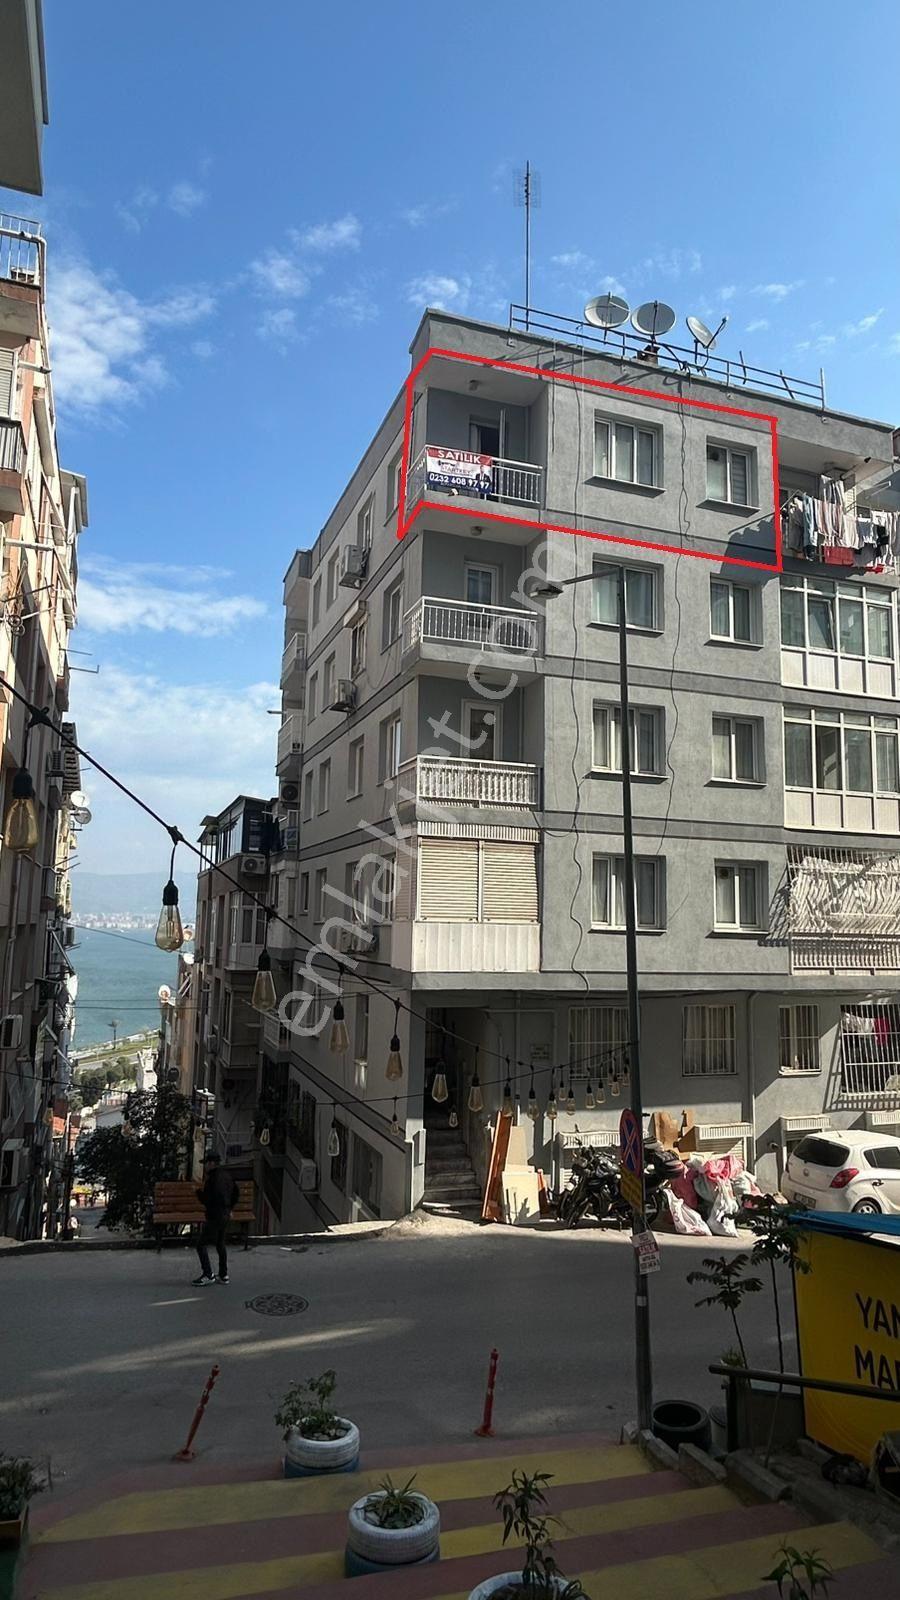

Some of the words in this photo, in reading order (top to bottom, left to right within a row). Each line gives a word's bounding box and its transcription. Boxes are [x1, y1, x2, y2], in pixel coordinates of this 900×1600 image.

[438, 450, 481, 464] SATILIK
[429, 473, 449, 483] 0232
[451, 478, 467, 486] 608
[468, 479, 478, 488] 97
[480, 481, 490, 490] 97
